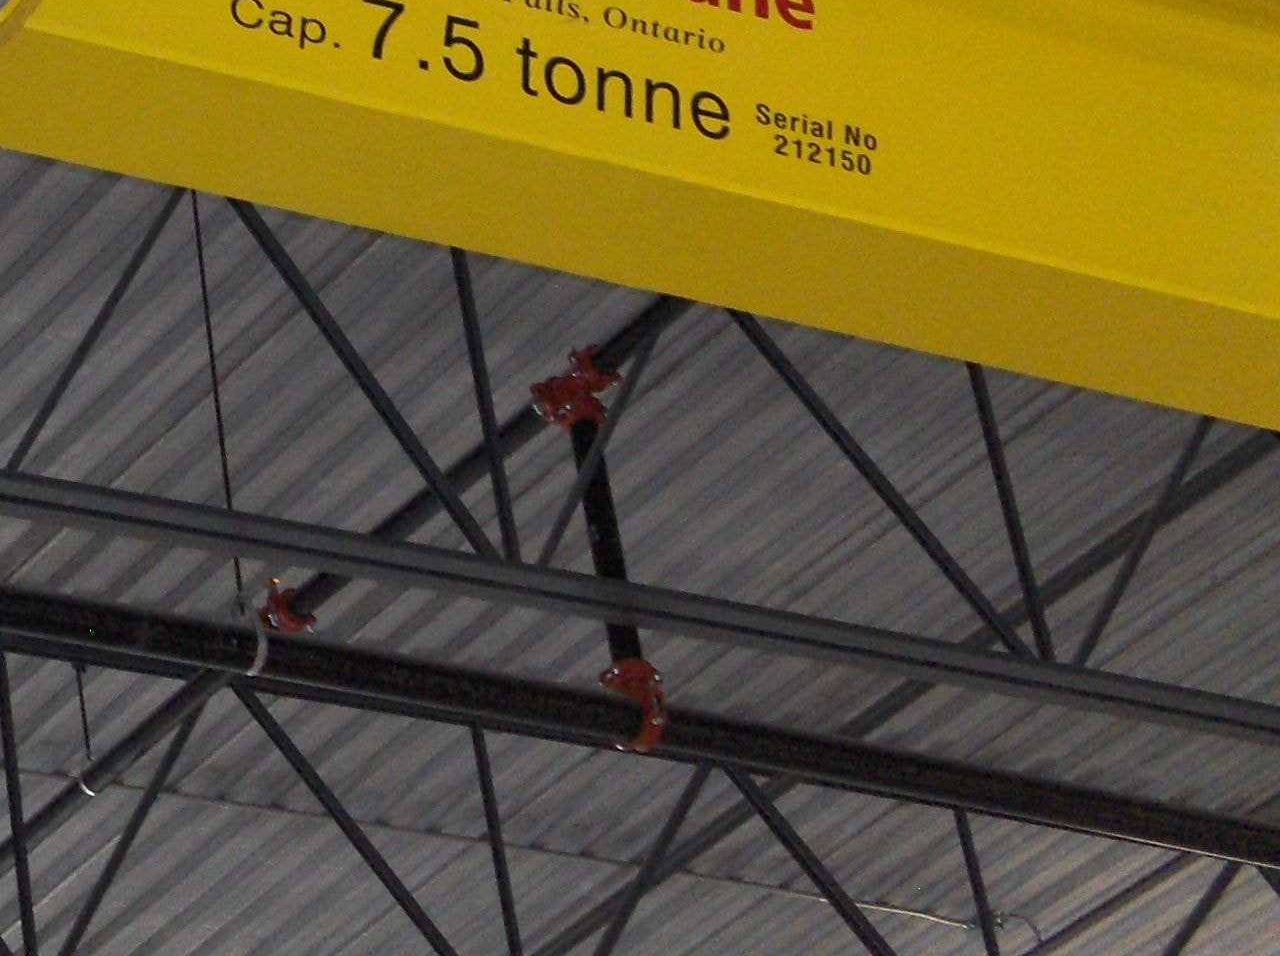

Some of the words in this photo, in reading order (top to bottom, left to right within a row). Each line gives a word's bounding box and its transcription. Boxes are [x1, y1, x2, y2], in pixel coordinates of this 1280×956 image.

[603, 6, 726, 54] Ontario
[516, 37, 731, 141] tonne
[756, 103, 834, 142] Serial
[845, 124, 878, 152] No
[773, 133, 872, 176] 212150
